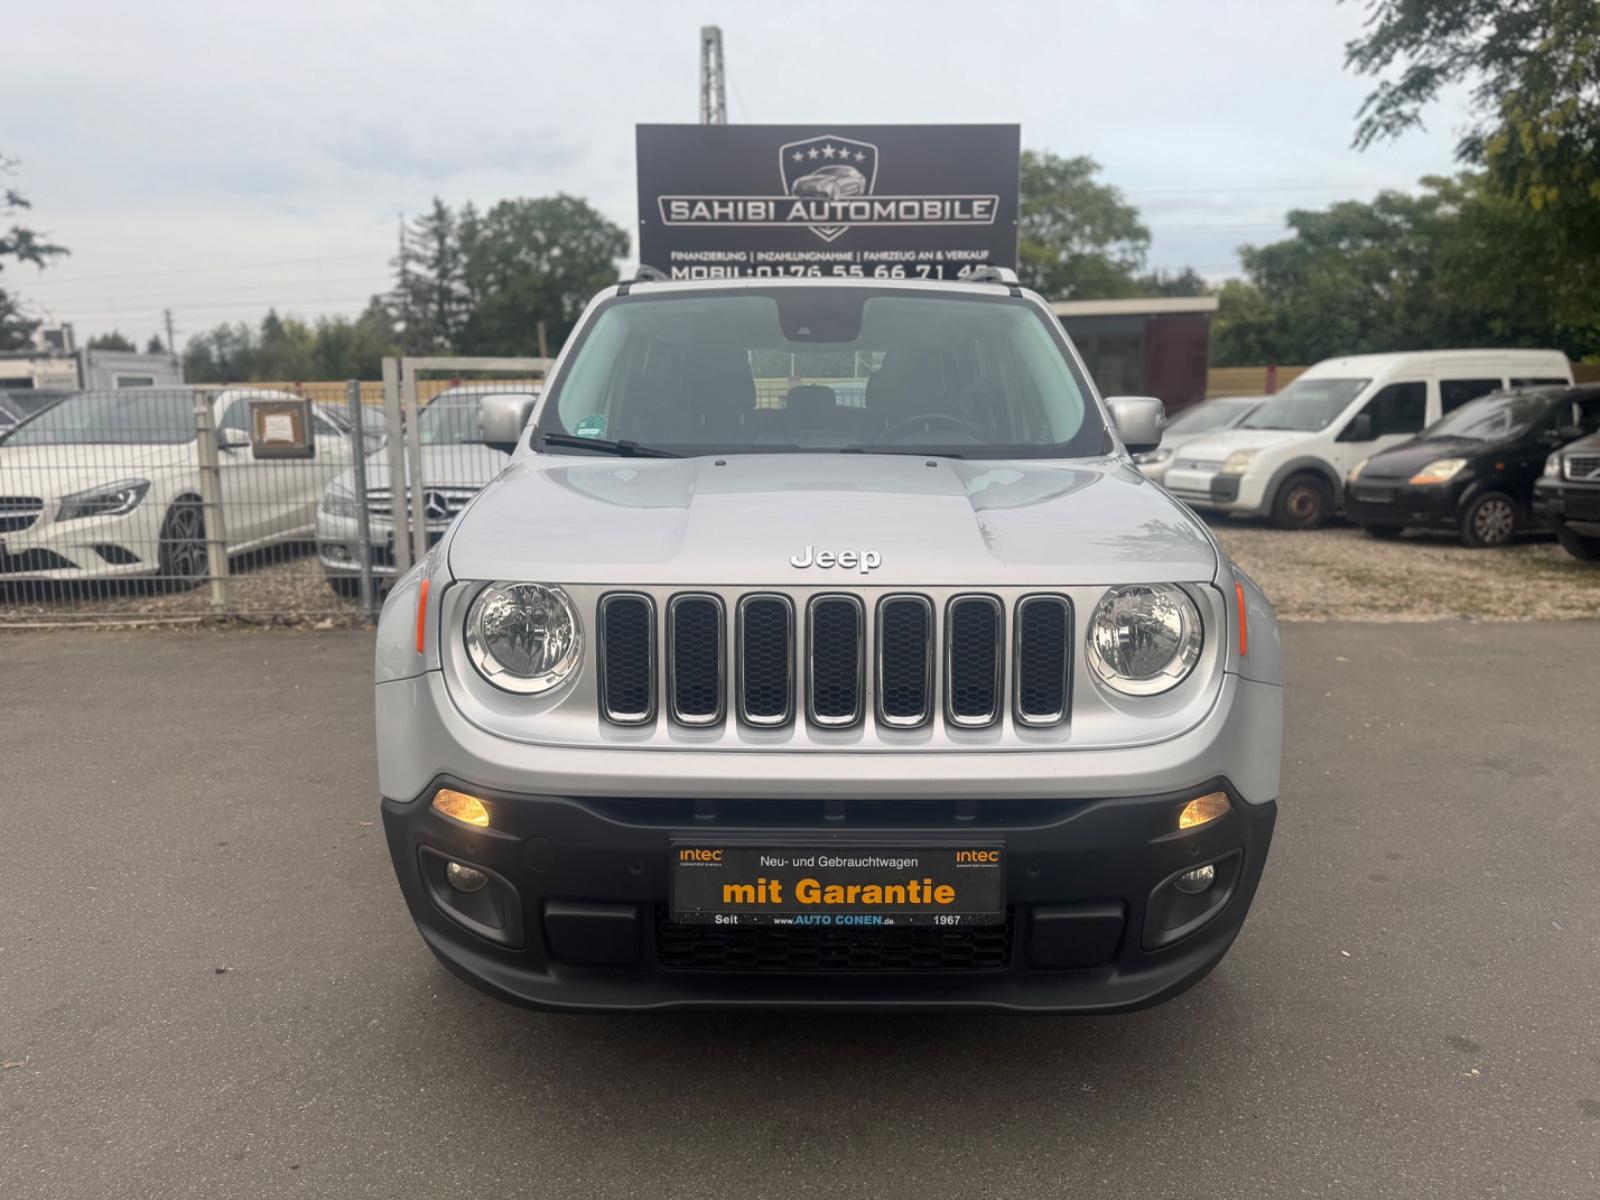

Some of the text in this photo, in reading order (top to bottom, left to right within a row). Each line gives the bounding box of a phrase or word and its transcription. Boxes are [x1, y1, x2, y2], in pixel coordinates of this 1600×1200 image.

[670, 200, 992, 221] SAHIBI AUTOMOBILE
[670, 251, 747, 261] FINANZIERUNG
[756, 251, 853, 261] INZAHLUNGNAHME
[863, 251, 915, 261] FAHRZEUG
[917, 250, 934, 261] AN
[935, 251, 944, 260] &
[945, 250, 990, 260] VERKAUF
[874, 264, 905, 279] 66
[915, 264, 944, 280] 71
[790, 544, 882, 575] Jeep
[679, 848, 723, 861] intec
[956, 849, 999, 862] intec
[760, 855, 919, 871] Neu- und Gebrauchtwagen
[722, 878, 956, 905] mit Garantie
[714, 914, 739, 925] Seit
[933, 915, 961, 925] 1967
